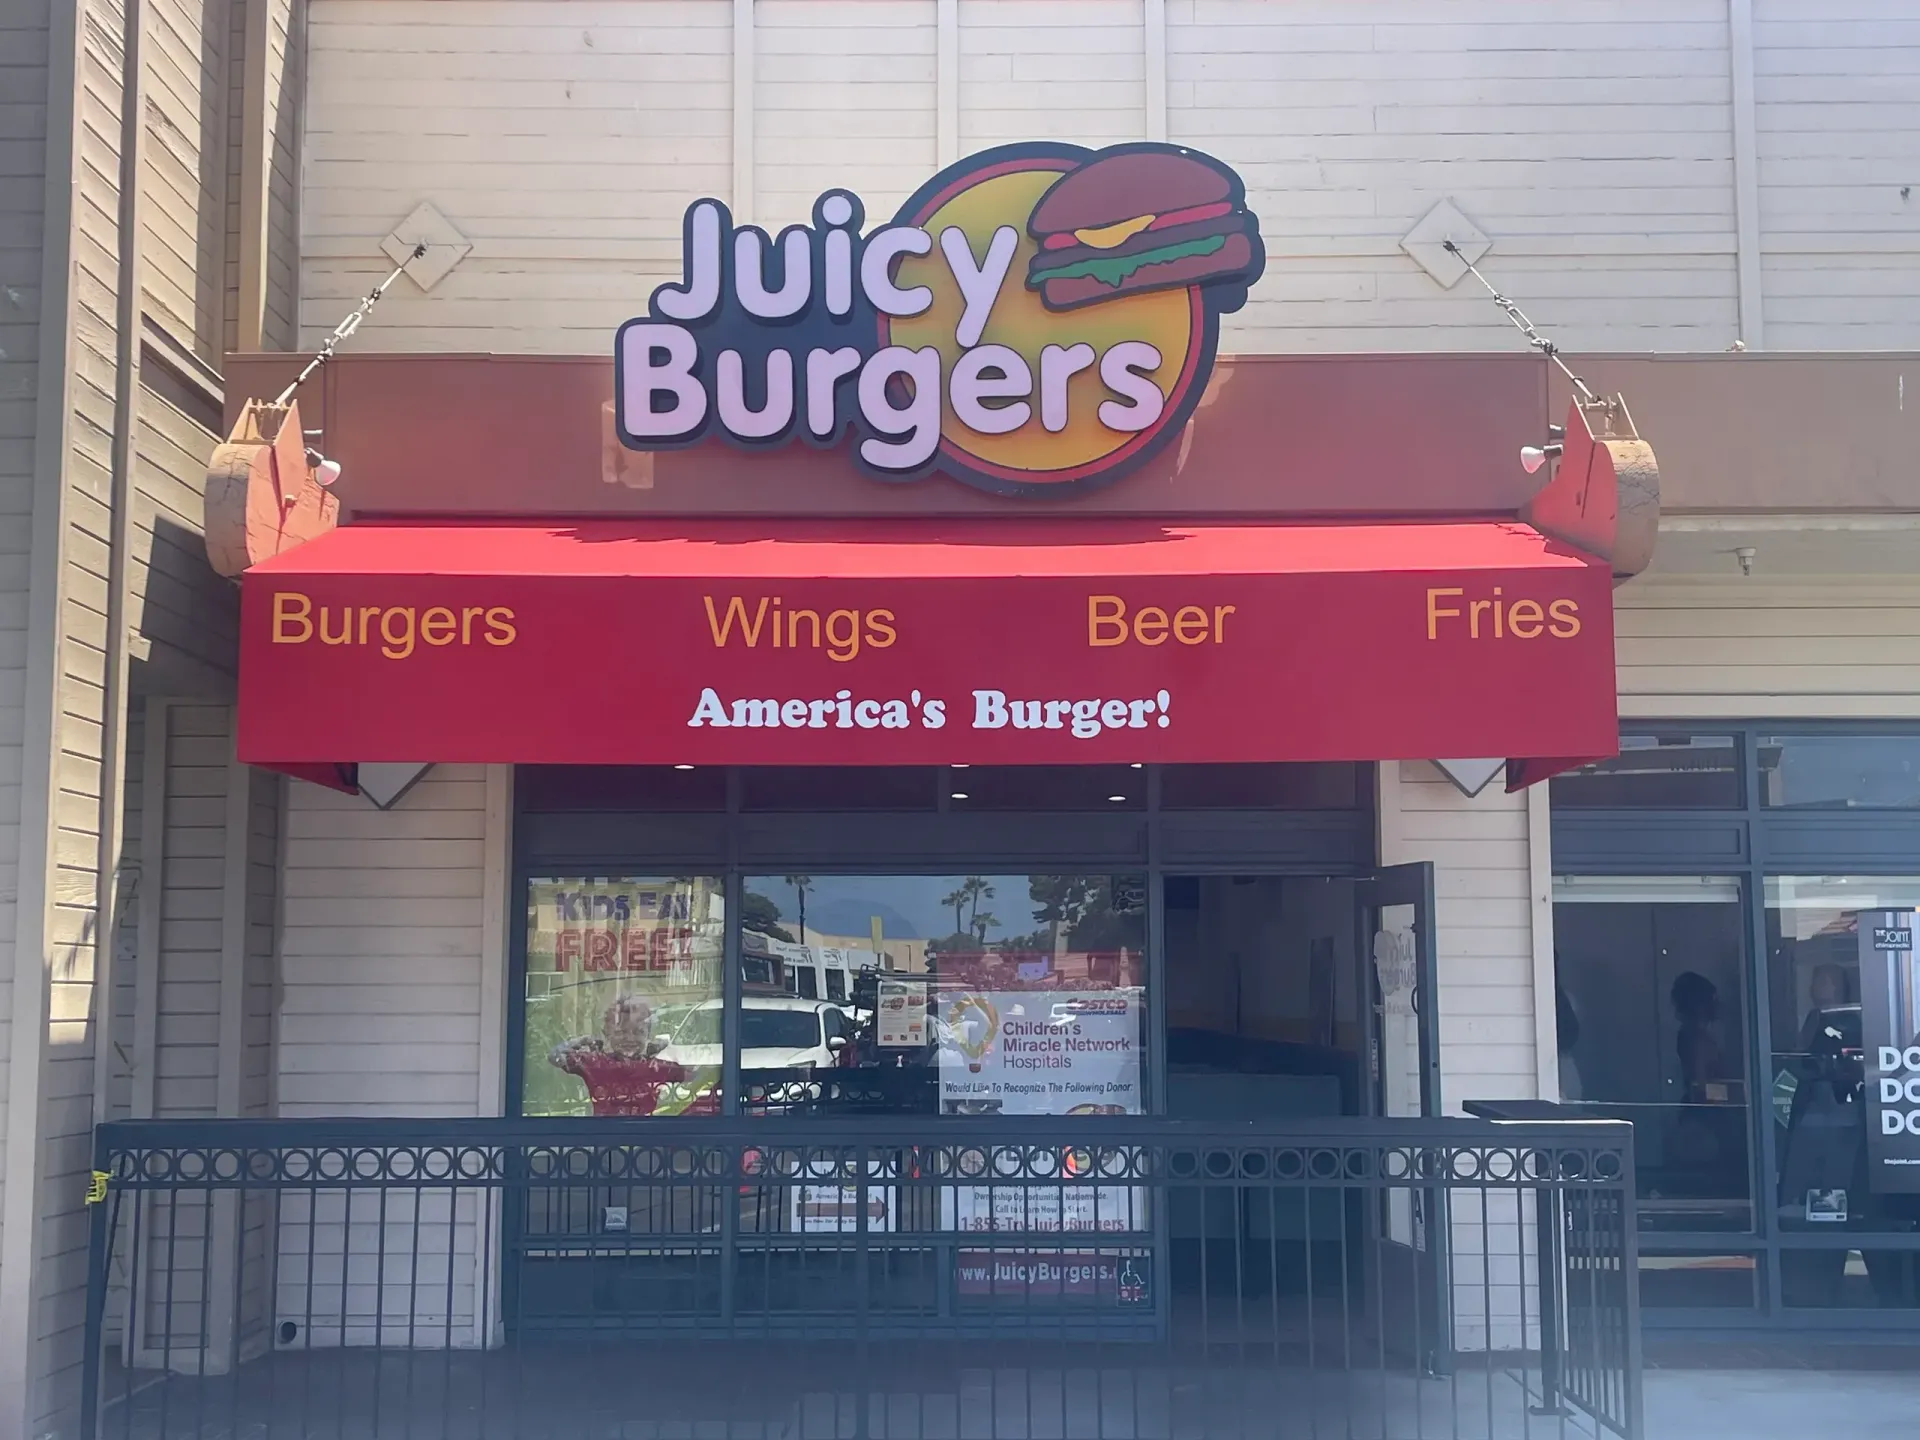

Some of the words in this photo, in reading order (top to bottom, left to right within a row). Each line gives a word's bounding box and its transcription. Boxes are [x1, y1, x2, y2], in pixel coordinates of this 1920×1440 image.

[656, 195, 1019, 348] Juicy
[622, 322, 1165, 470] Burgers
[271, 592, 517, 660] Burgers
[703, 595, 897, 662] Wings
[1087, 594, 1236, 647] Beer
[1426, 586, 1582, 641] Fries
[687, 687, 946, 729] America's
[972, 689, 1171, 739] Burger!
[1003, 1021, 1081, 1036] Children's
[1003, 1038, 1061, 1052] Miracle
[1065, 1037, 1131, 1052] Network
[1003, 1055, 1072, 1071] Hospitals
[945, 1082, 971, 1093] Would
[991, 1083, 1002, 1093] To
[1003, 1082, 1046, 1095] Recognize
[1048, 1082, 1063, 1093] The
[1064, 1082, 1104, 1095] Following
[974, 1192, 1013, 1202] Ownrship
[995, 1205, 1009, 1214] Call
[1019, 1206, 1040, 1214] Larn
[1041, 1206, 1057, 1214] How
